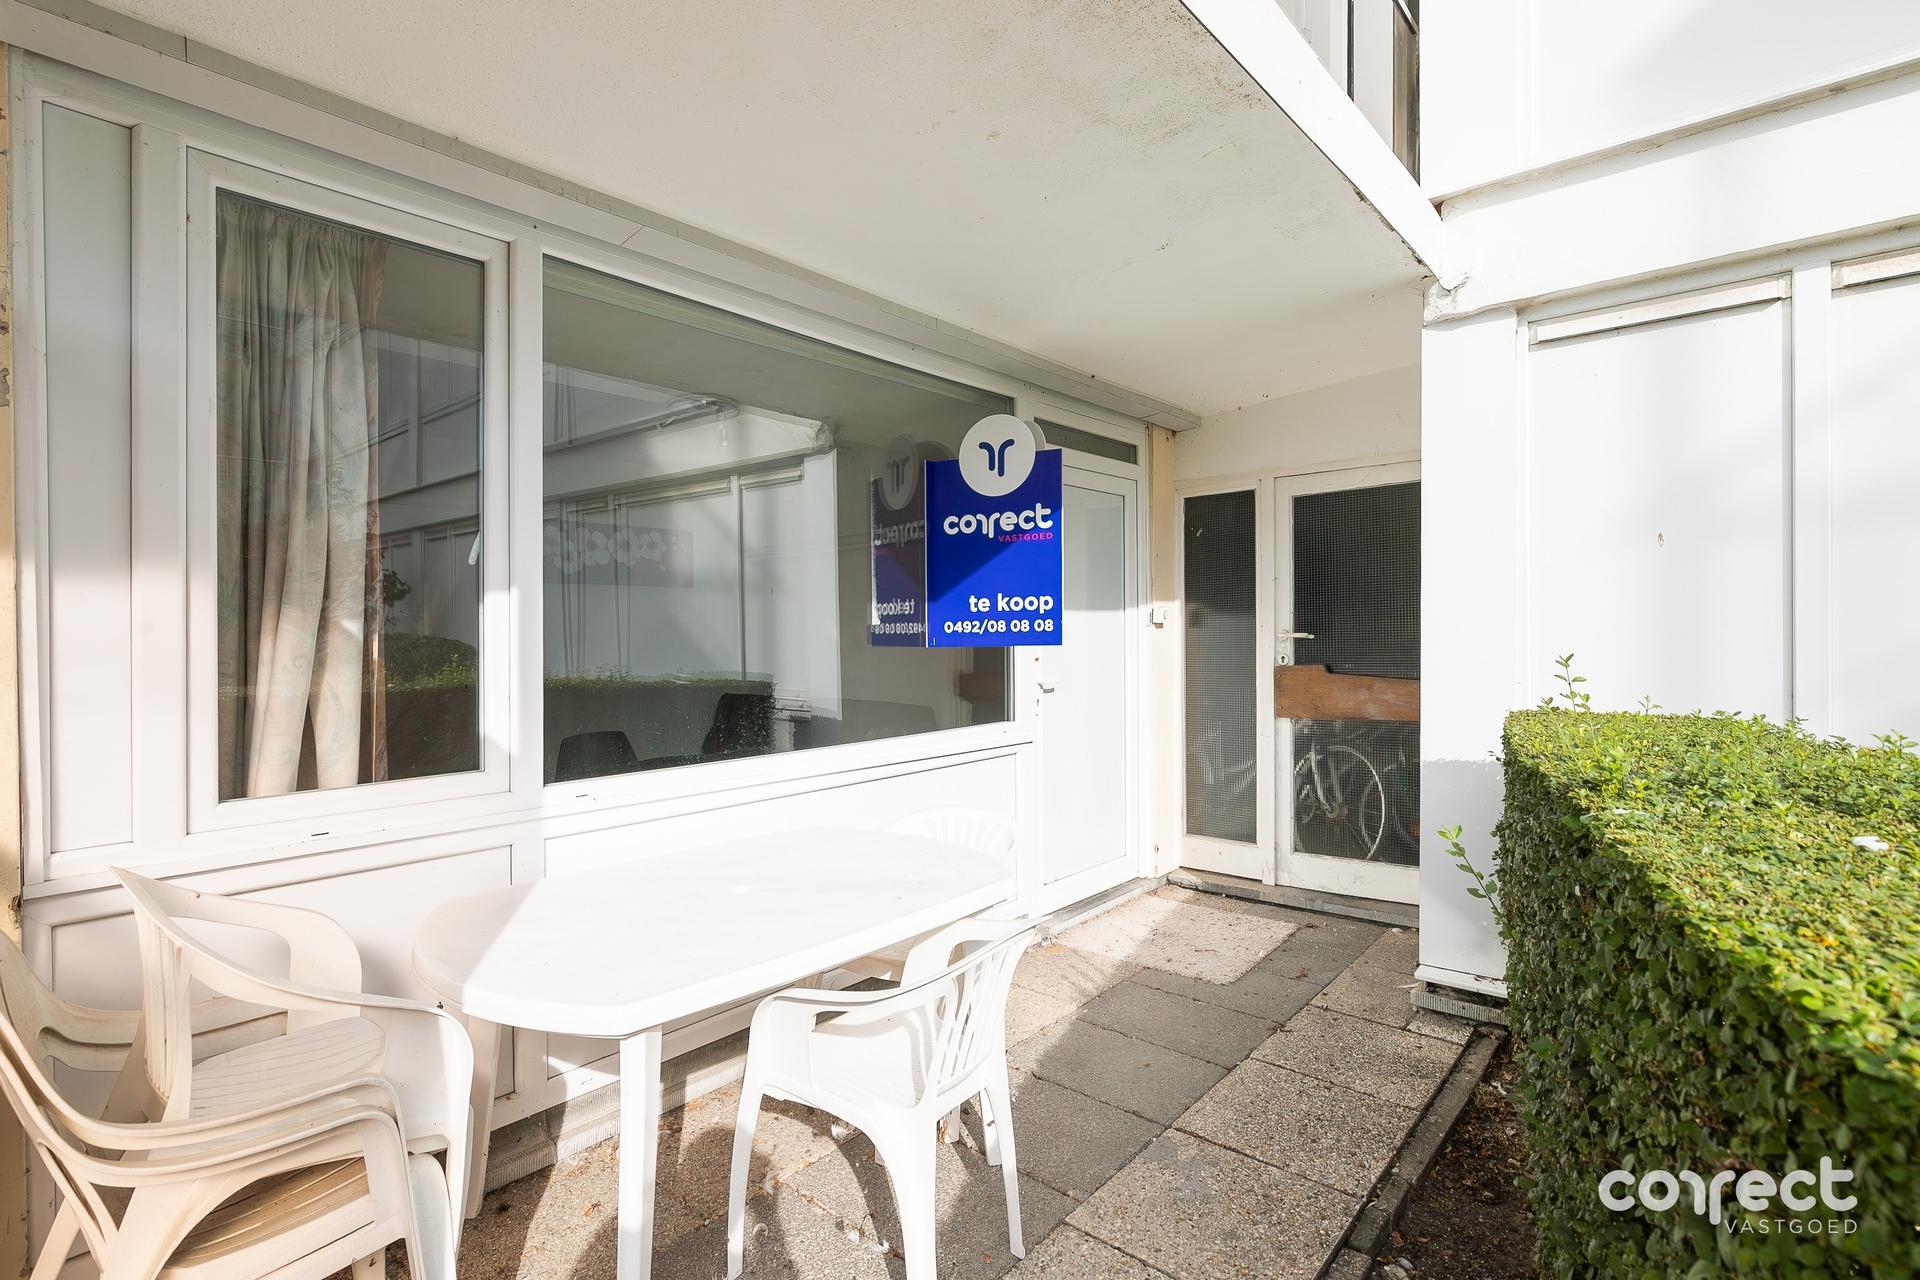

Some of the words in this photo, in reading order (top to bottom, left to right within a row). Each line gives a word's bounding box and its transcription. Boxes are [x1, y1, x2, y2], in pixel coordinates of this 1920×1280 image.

[943, 503, 1054, 539] correct
[998, 532, 1053, 543] VASTGOED
[969, 594, 991, 613] te
[997, 592, 1054, 614] koop
[944, 619, 1007, 635] 0492/08
[1010, 619, 1030, 633] 08
[1033, 618, 1054, 633] 08
